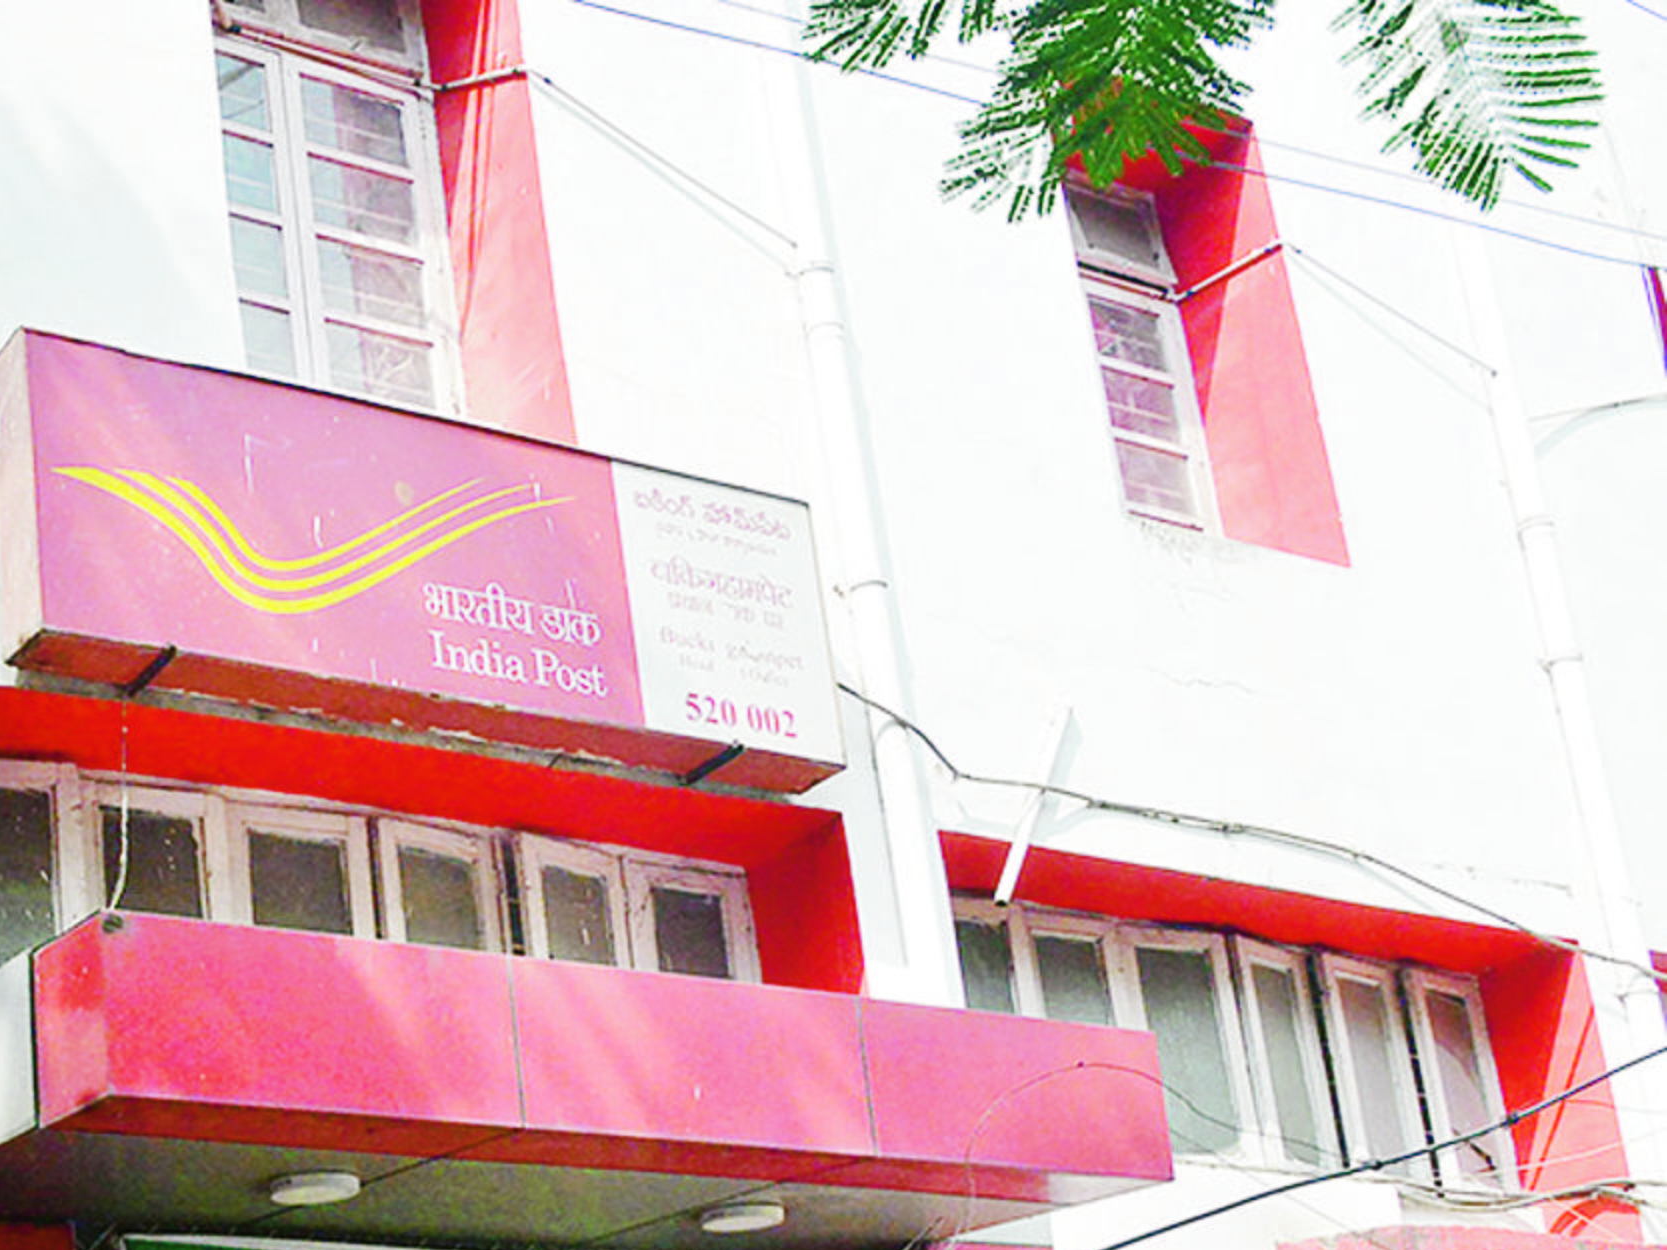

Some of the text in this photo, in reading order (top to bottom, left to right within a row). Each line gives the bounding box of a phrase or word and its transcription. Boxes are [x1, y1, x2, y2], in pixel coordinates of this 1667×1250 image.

[423, 582, 602, 647] भारतीय डाक
[428, 628, 608, 698] India Post
[685, 692, 797, 738] 520 002
